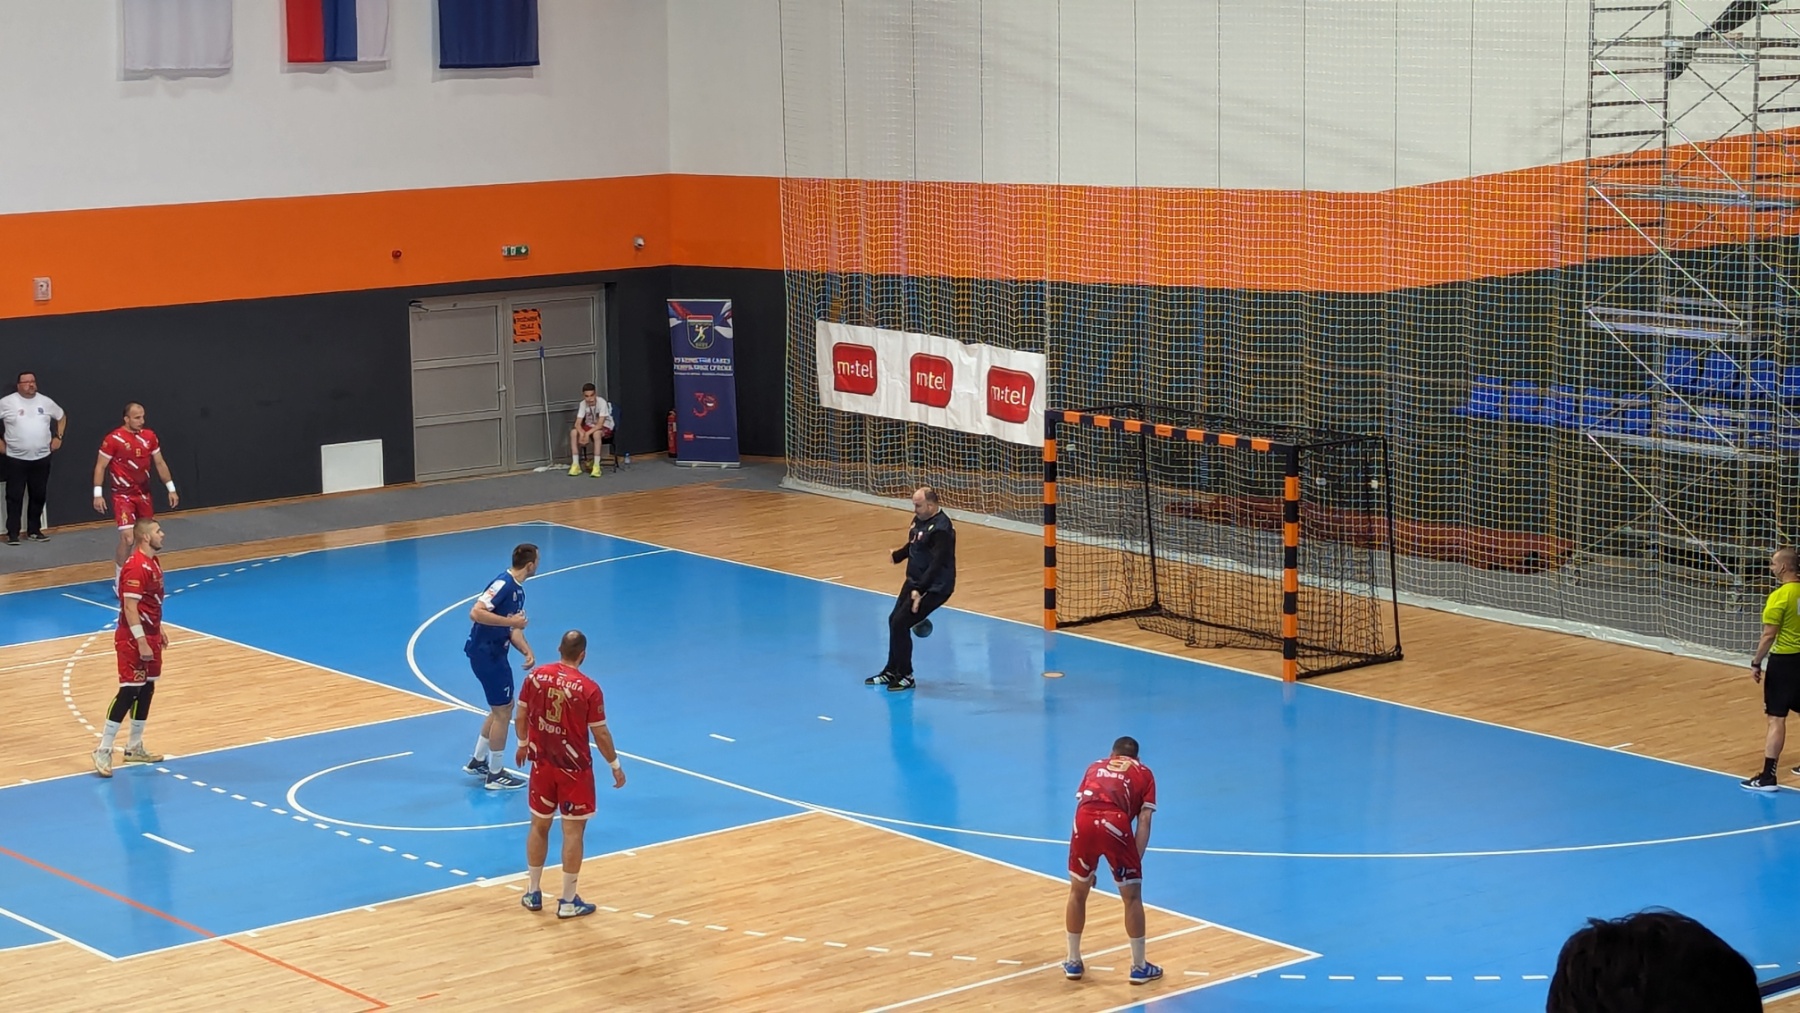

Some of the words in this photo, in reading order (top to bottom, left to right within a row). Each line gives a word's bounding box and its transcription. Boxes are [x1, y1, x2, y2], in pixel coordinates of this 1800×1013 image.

[836, 359, 874, 379] m:tel
[990, 385, 1027, 406] m:tel
[503, 686, 510, 698] 7
[546, 686, 565, 723] 3
